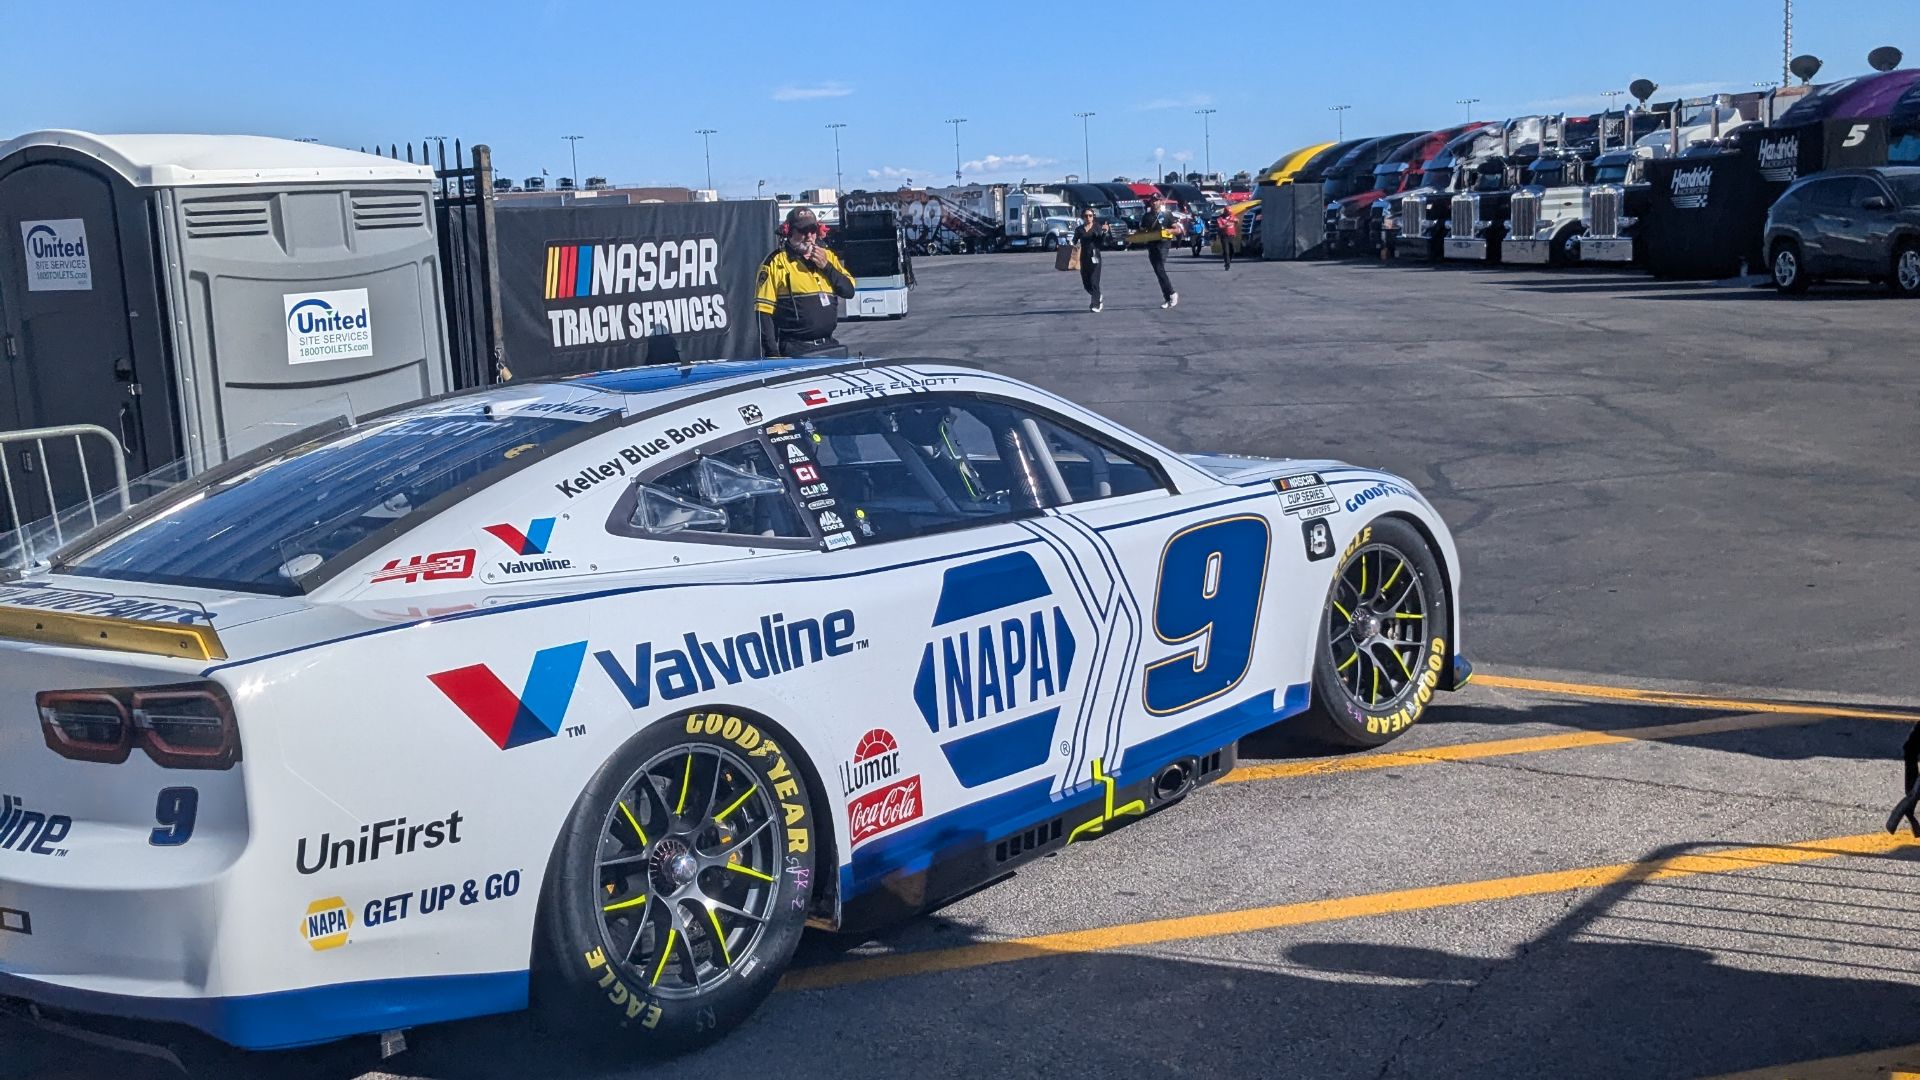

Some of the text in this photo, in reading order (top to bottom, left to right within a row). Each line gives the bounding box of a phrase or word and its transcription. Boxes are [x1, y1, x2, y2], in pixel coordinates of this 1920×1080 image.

[1842, 124, 1870, 148] 5
[1670, 165, 1713, 195] Hendrick
[32, 236, 85, 259] United
[35, 259, 87, 270] SITE SERVICES
[592, 238, 718, 296] NASCAR
[297, 308, 367, 334] United
[299, 331, 368, 346] SITE SERVICES
[547, 294, 727, 347] TRACK SERVICES
[300, 343, 369, 357] 1800TOILETS.com
[828, 377, 960, 399] CHASE ELLIOTT
[555, 417, 720, 498] Kelley Blue Book
[1288, 475, 1317, 489] NASCAR
[1287, 488, 1326, 505] CUP SERIES
[498, 558, 572, 574] Valvoline
[1142, 513, 1272, 718] 9
[593, 609, 855, 710] Valvoline
[942, 610, 1055, 729] NAPA
[1366, 637, 1445, 734] GOODYEAR
[686, 713, 809, 854] GOODYEAR
[839, 751, 900, 797] LLumar
[149, 786, 199, 846] 9
[850, 779, 920, 841] Coca-Cola
[296, 810, 464, 875] UniFirst
[363, 870, 520, 927] GET UP & GO
[308, 909, 347, 938] NAPA
[585, 946, 663, 1029] EAGLE
